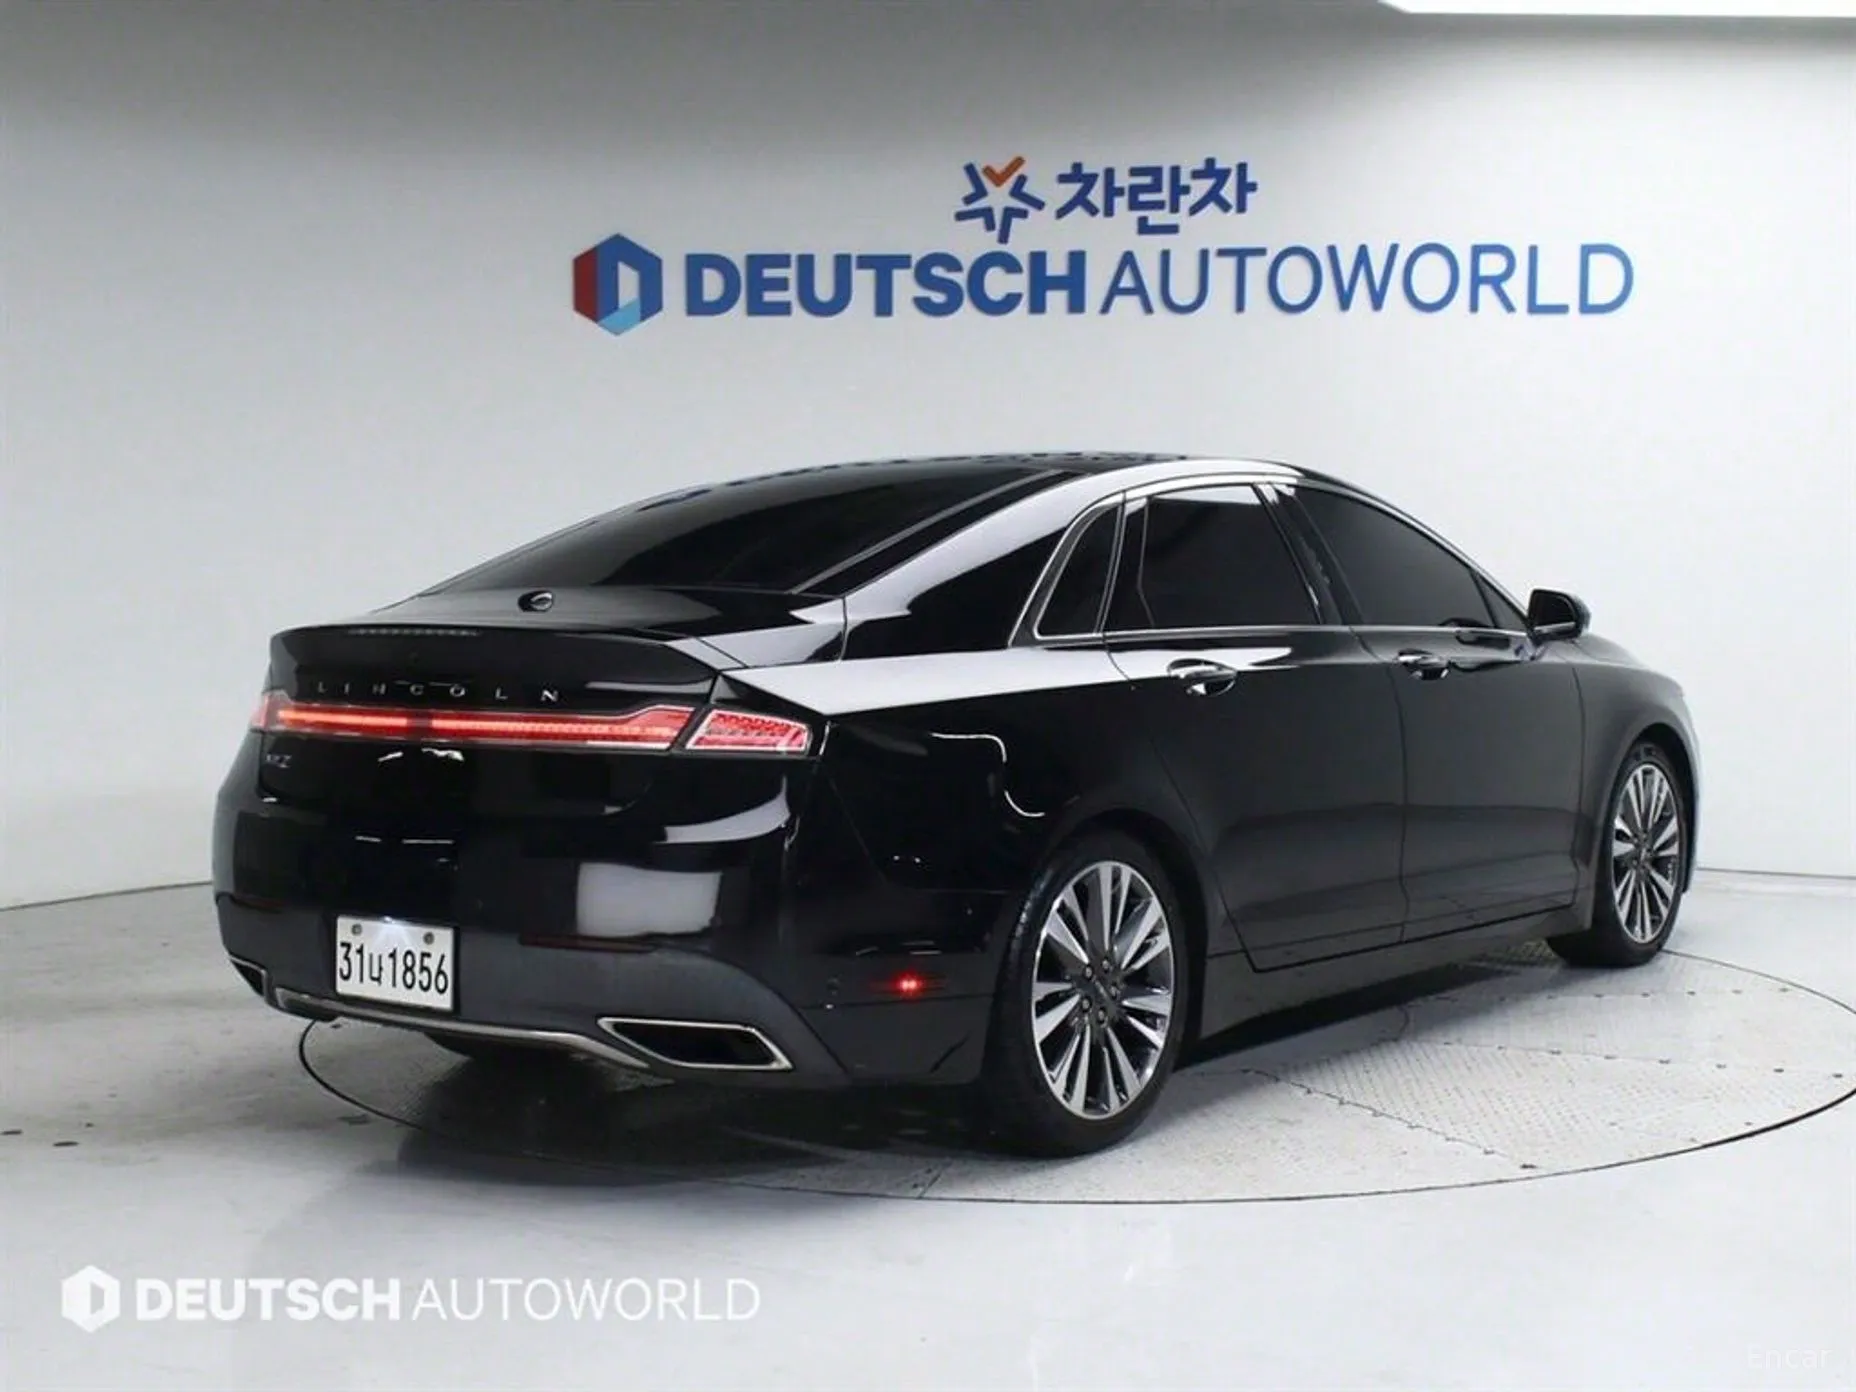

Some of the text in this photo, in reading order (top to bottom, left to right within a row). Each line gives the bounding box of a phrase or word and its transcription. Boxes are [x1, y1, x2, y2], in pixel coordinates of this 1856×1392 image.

[1056, 157, 1258, 236] 차란차
[685, 242, 1635, 317] DEUTSCH AUTOWORLD
[316, 680, 559, 702] LINCOLN
